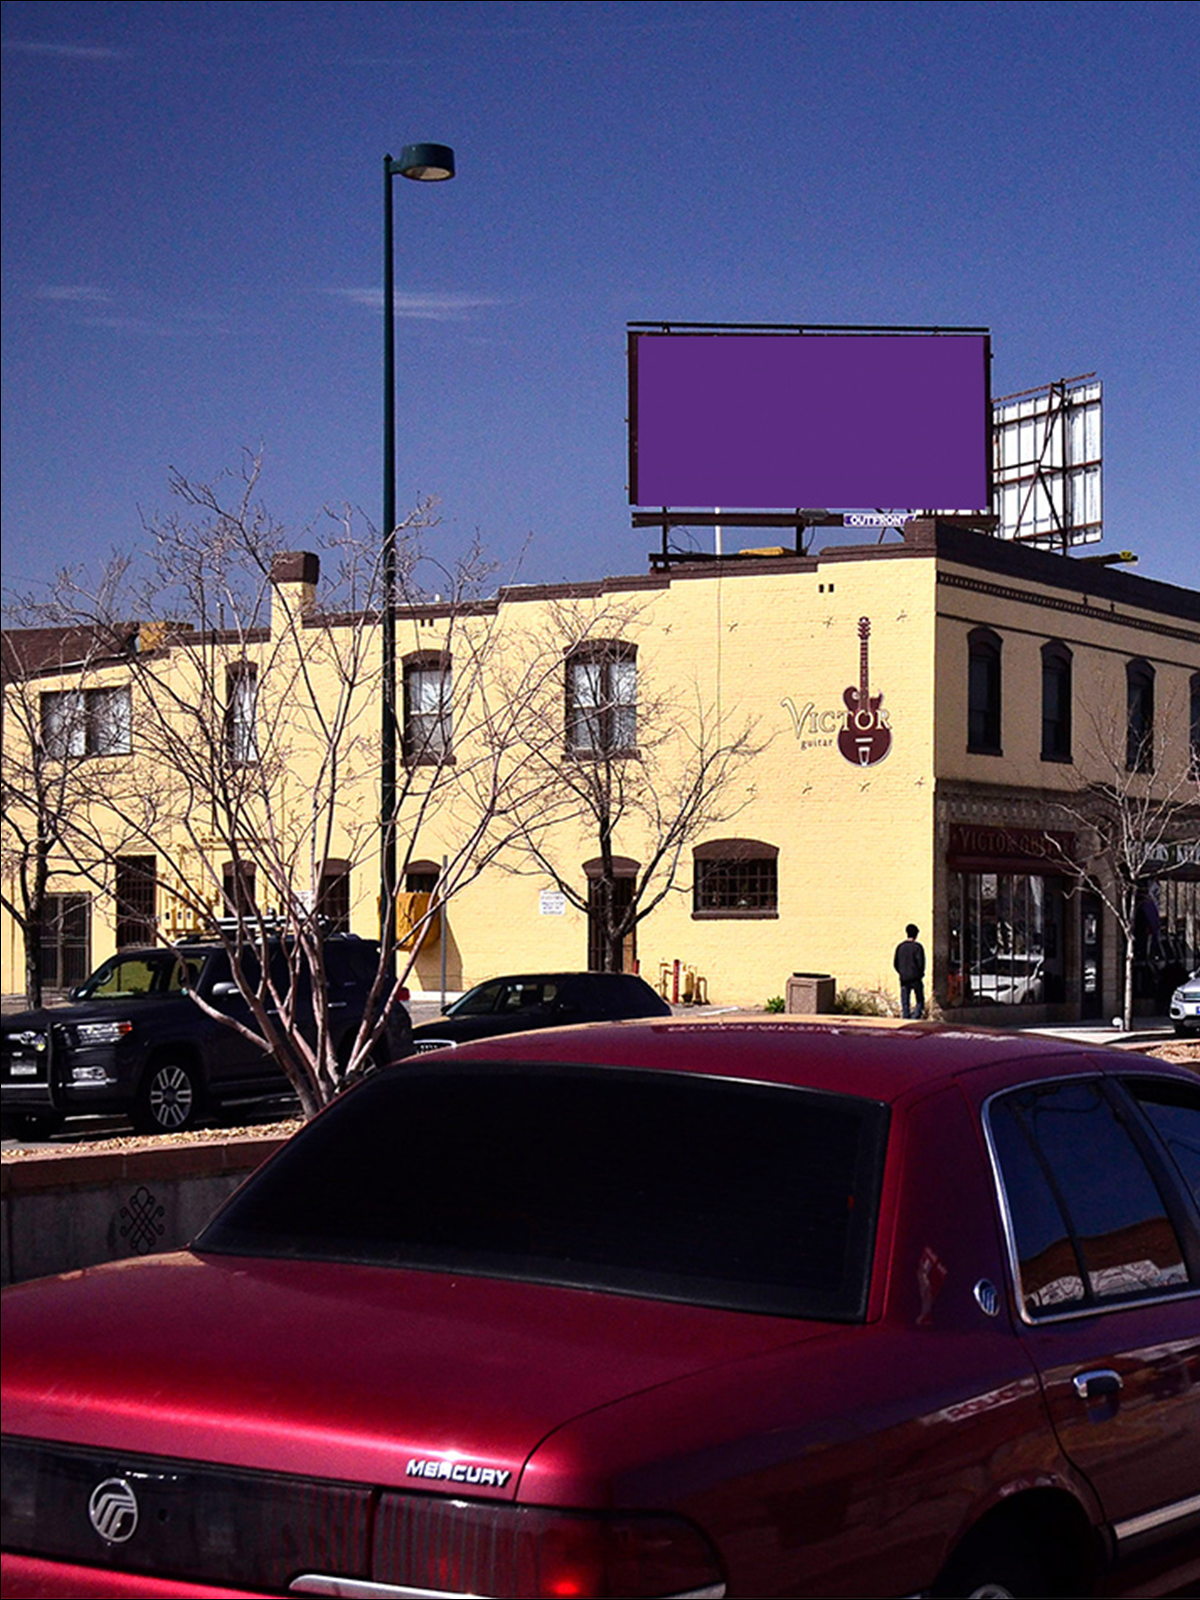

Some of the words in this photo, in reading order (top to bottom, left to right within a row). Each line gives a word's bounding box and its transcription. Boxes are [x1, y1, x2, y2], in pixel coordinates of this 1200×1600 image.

[780, 696, 893, 740] VICTOR
[800, 738, 833, 751] guitar
[406, 1459, 511, 1487] MERCURY
